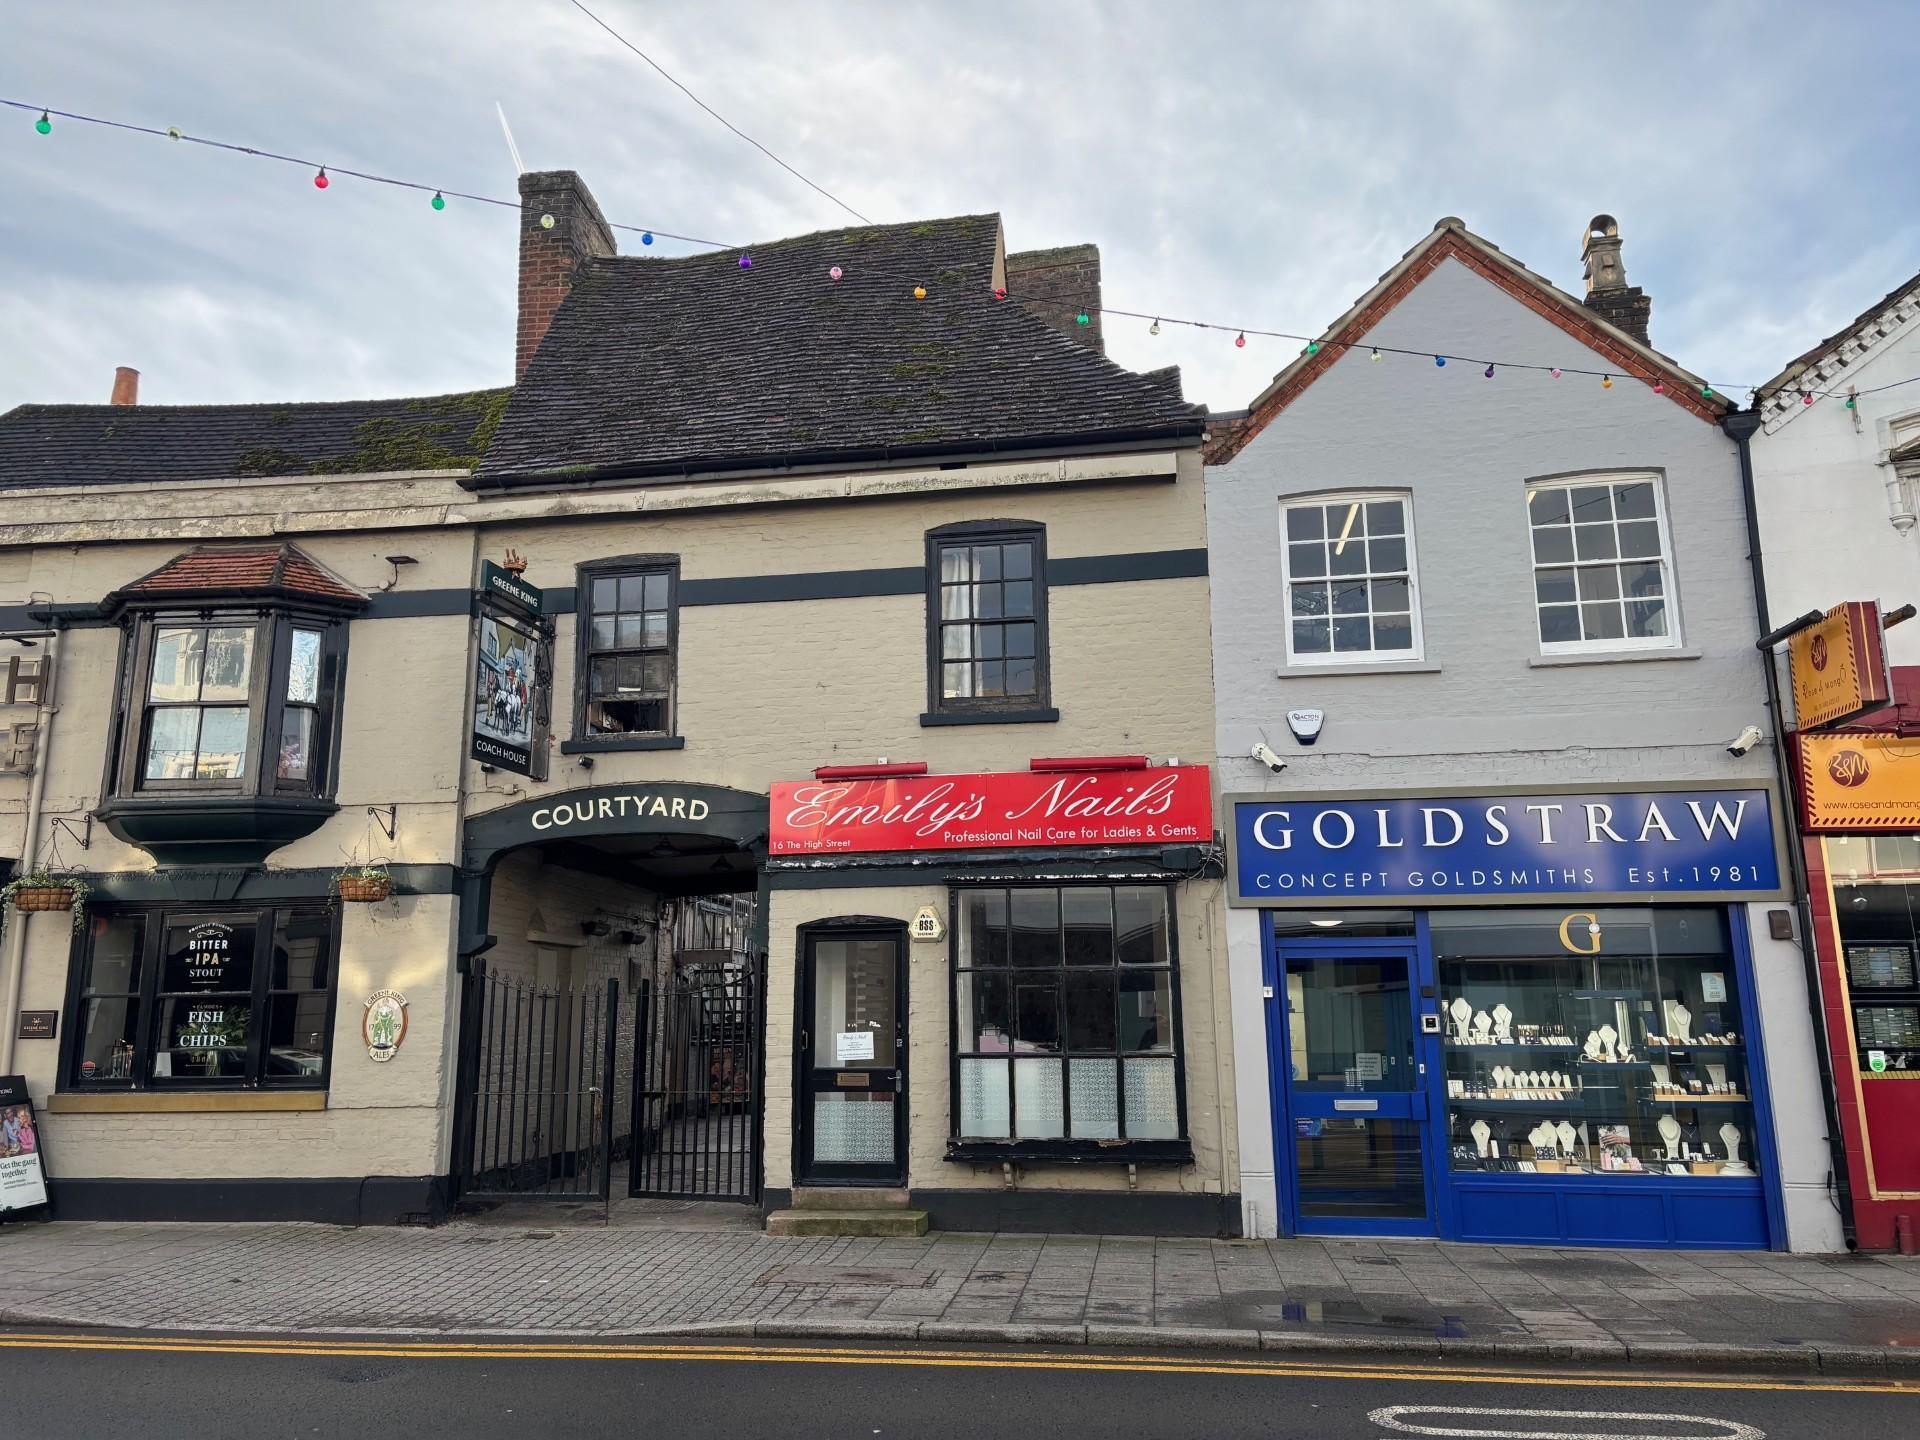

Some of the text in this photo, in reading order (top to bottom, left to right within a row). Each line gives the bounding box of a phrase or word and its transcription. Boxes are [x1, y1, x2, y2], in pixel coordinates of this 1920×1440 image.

[492, 575, 538, 608] GREENE KING
[5, 655, 51, 706] H
[476, 740, 526, 766] COACH HOUSE
[785, 774, 1179, 837] Emily's Nails
[531, 796, 709, 830] COURTYARD
[1252, 800, 1749, 851] GOLDSTRAW
[944, 824, 1197, 843] Professional Nail Care for Ladies & Gents
[772, 839, 851, 850] 16 The High Street
[1256, 872, 1389, 889] CONCEPT
[1407, 868, 1595, 887] GOLDSMITHS
[919, 919, 934, 931] BSS
[189, 939, 229, 950] BITTER
[195, 952, 219, 965] IPA
[188, 968, 224, 978] STOUT
[390, 991, 405, 1004] KING
[188, 1011, 225, 1023] FISH
[200, 1024, 209, 1034] &
[179, 1034, 227, 1047] CHIPS
[373, 1050, 390, 1059] ALES
[0, 1158, 37, 1170] Get the gang
[1, 1168, 28, 1179] together
